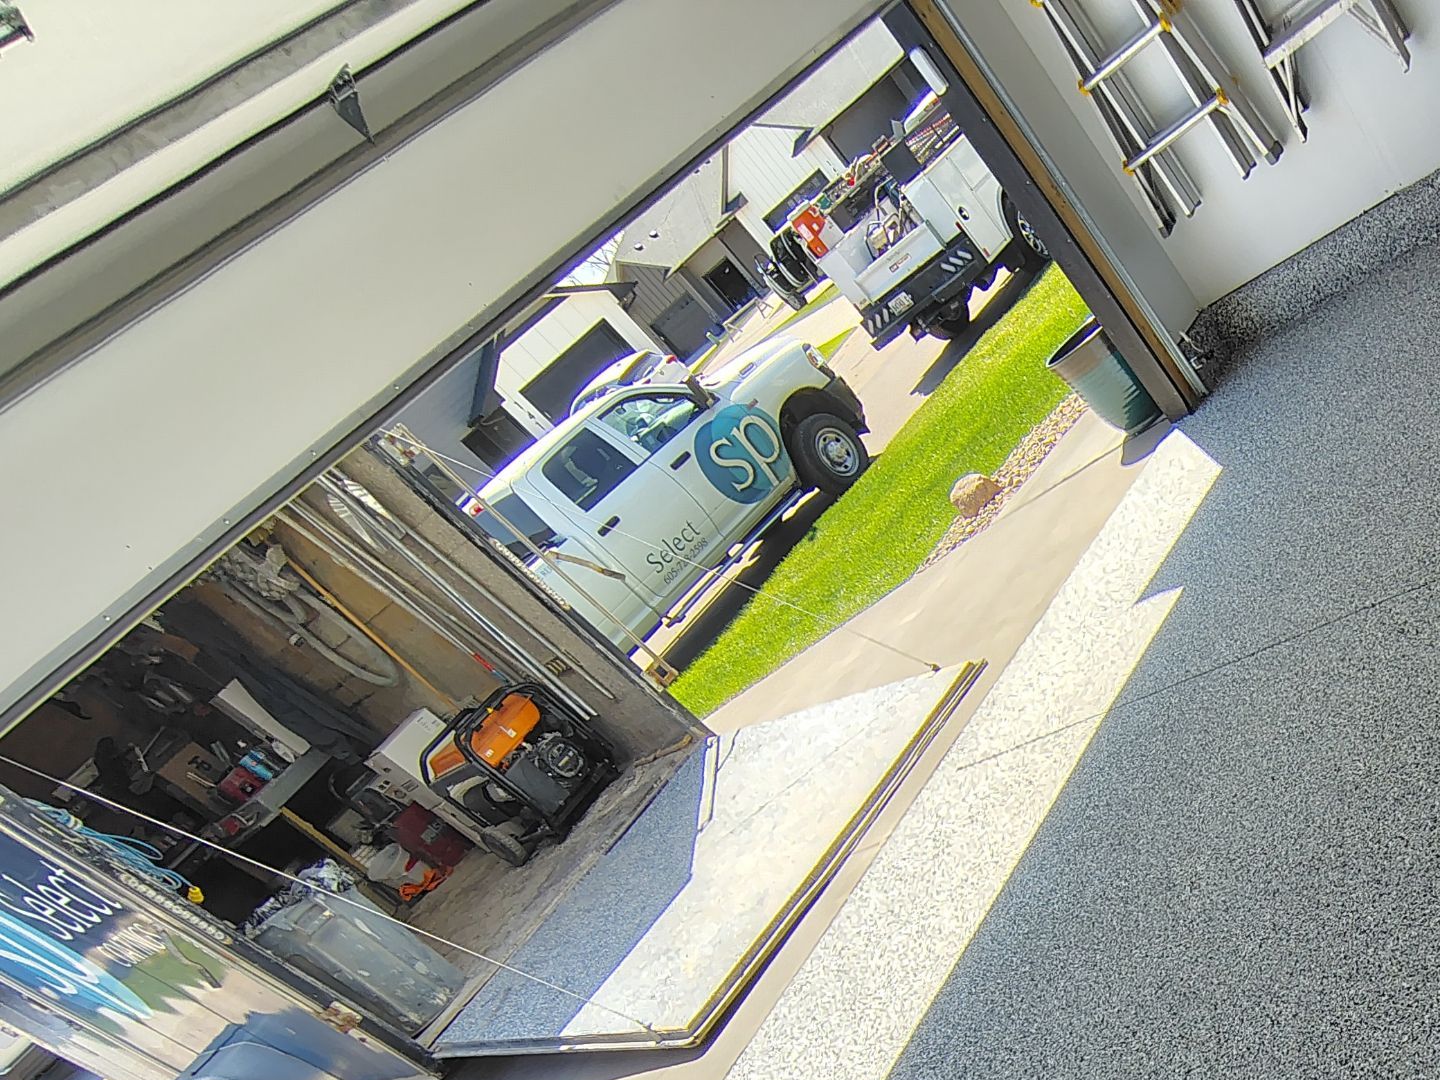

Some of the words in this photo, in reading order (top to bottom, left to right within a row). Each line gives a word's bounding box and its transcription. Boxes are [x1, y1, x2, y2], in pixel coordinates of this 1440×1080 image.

[709, 415, 780, 492] sp
[646, 519, 701, 574] Select
[0, 859, 123, 941] Select
[95, 922, 166, 968] COATINGS
